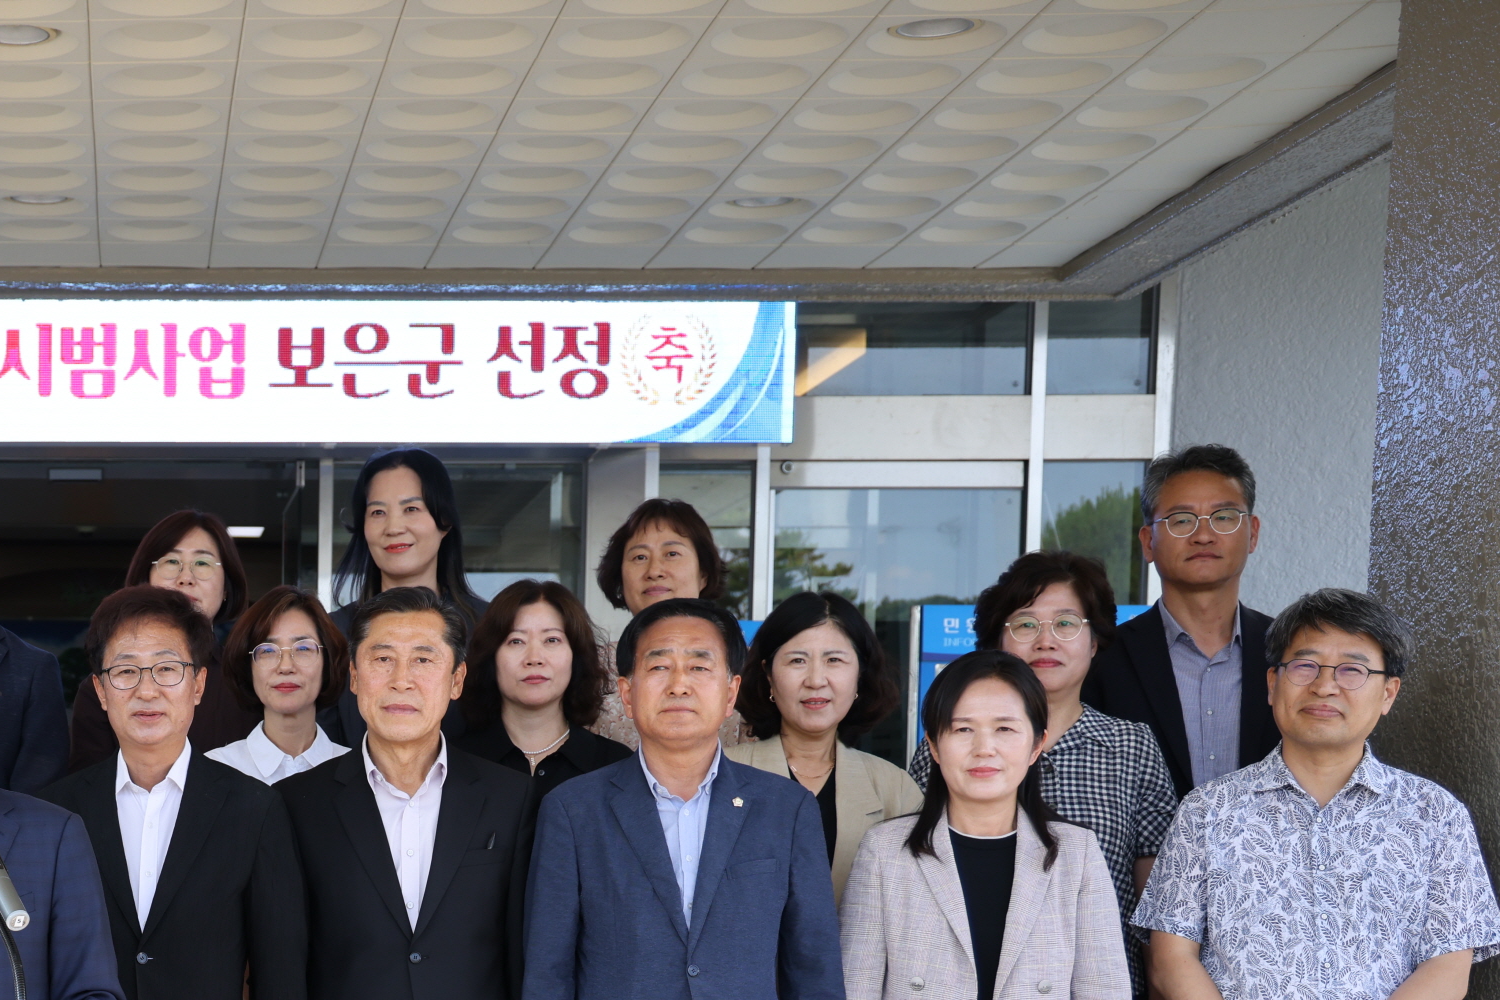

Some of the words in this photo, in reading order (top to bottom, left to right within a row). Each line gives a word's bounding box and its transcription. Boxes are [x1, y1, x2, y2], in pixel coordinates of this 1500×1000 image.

[269, 323, 463, 399] 보은군
[487, 323, 610, 398] 선정
[645, 326, 693, 384] 축
